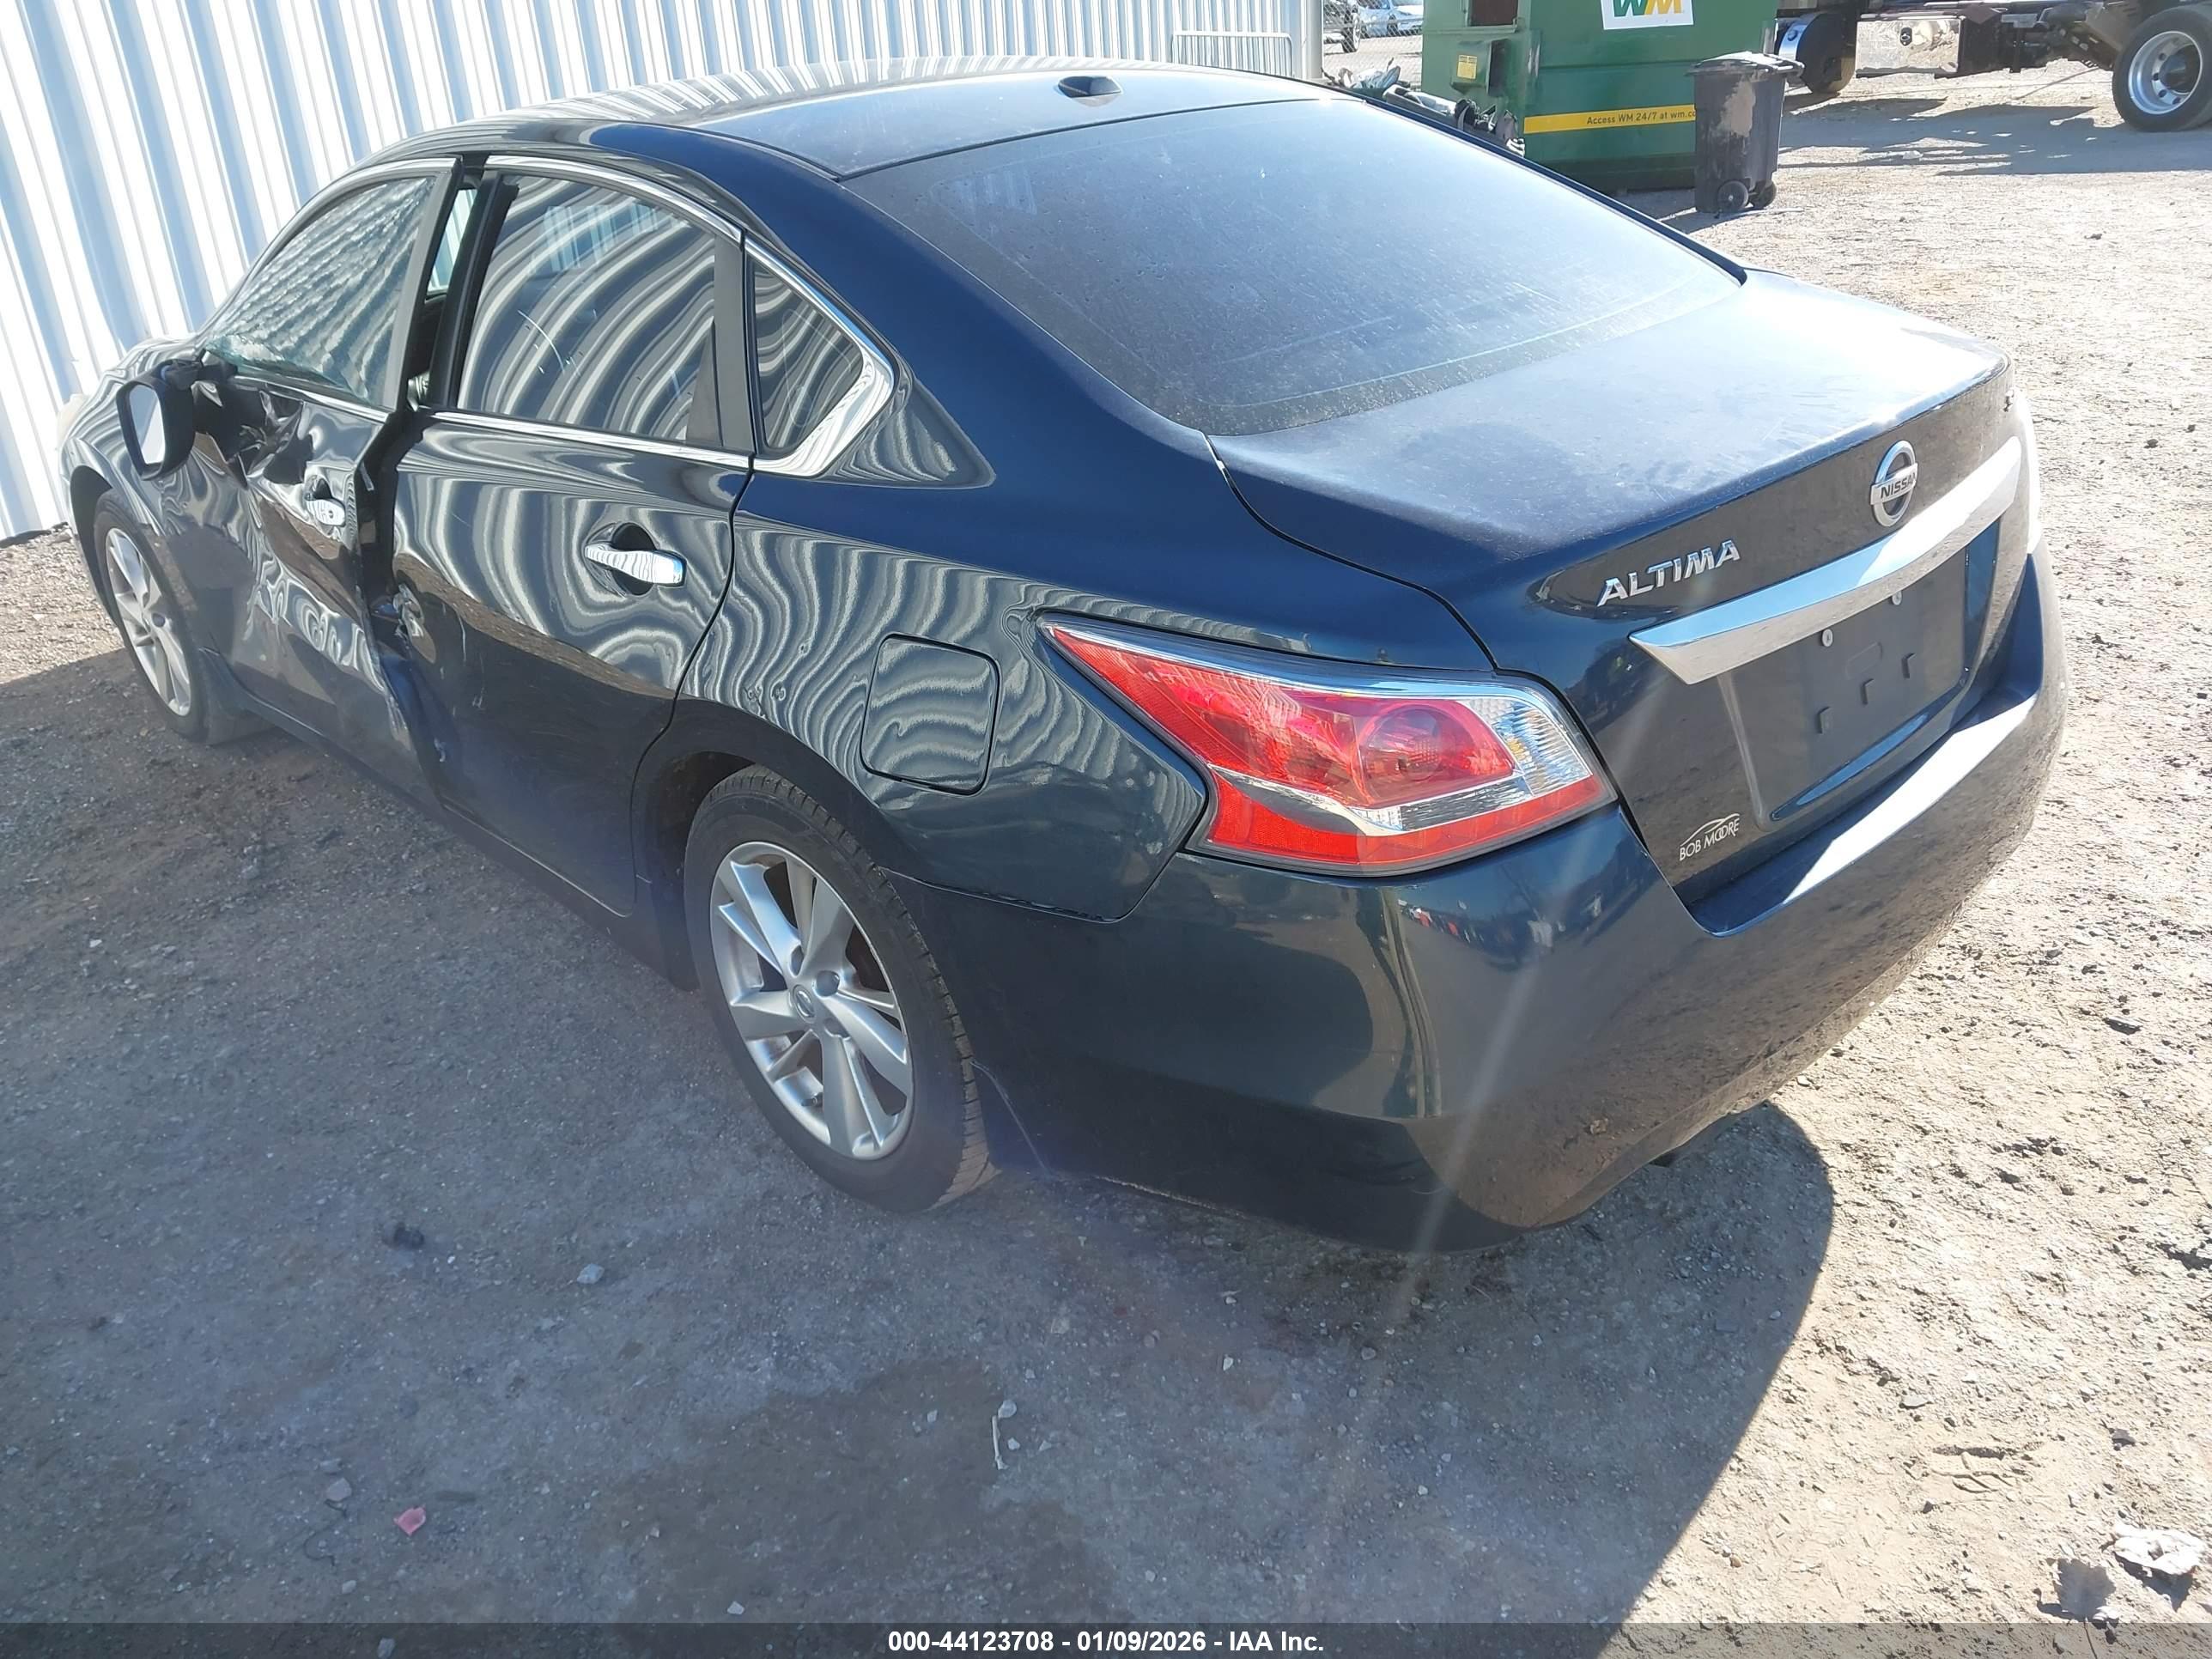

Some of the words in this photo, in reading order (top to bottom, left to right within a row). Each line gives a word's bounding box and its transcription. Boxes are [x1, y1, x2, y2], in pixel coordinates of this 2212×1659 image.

[1587, 115, 1615, 125] Access
[1618, 112, 1633, 122] WM
[1636, 111, 1657, 121] 24/7
[1881, 471, 1917, 499] NISSAN
[1596, 539, 1741, 607] ALTIMA
[1680, 839, 1701, 861] BOB
[1704, 817, 1740, 849] MOORE
